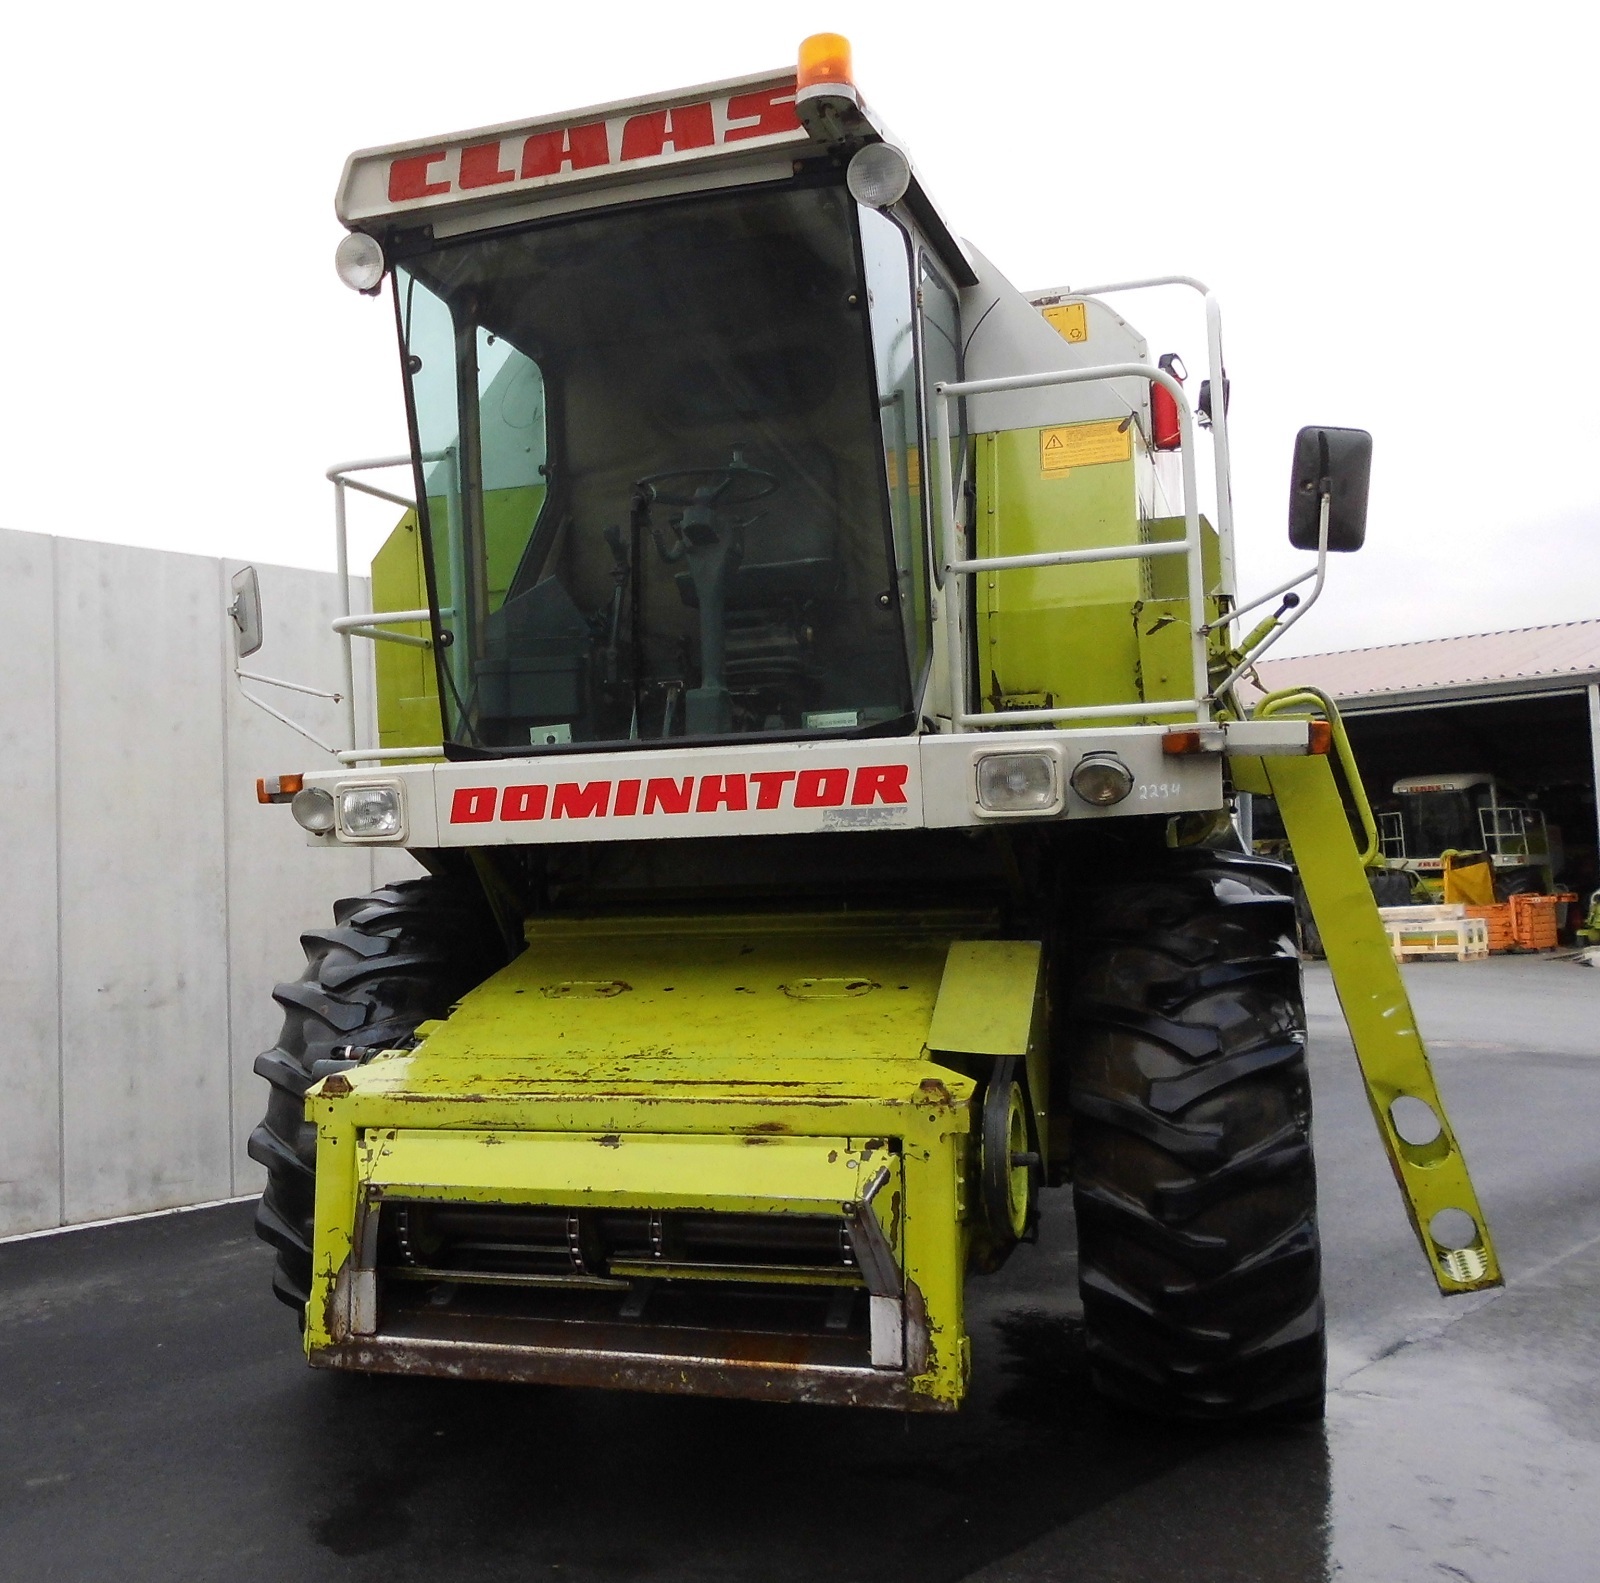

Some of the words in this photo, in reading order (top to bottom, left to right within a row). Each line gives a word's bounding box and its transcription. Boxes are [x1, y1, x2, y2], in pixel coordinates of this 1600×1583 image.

[387, 85, 801, 203] CLAAS
[449, 764, 909, 824] DOMINATOR
[1139, 783, 1180, 800] 2294
